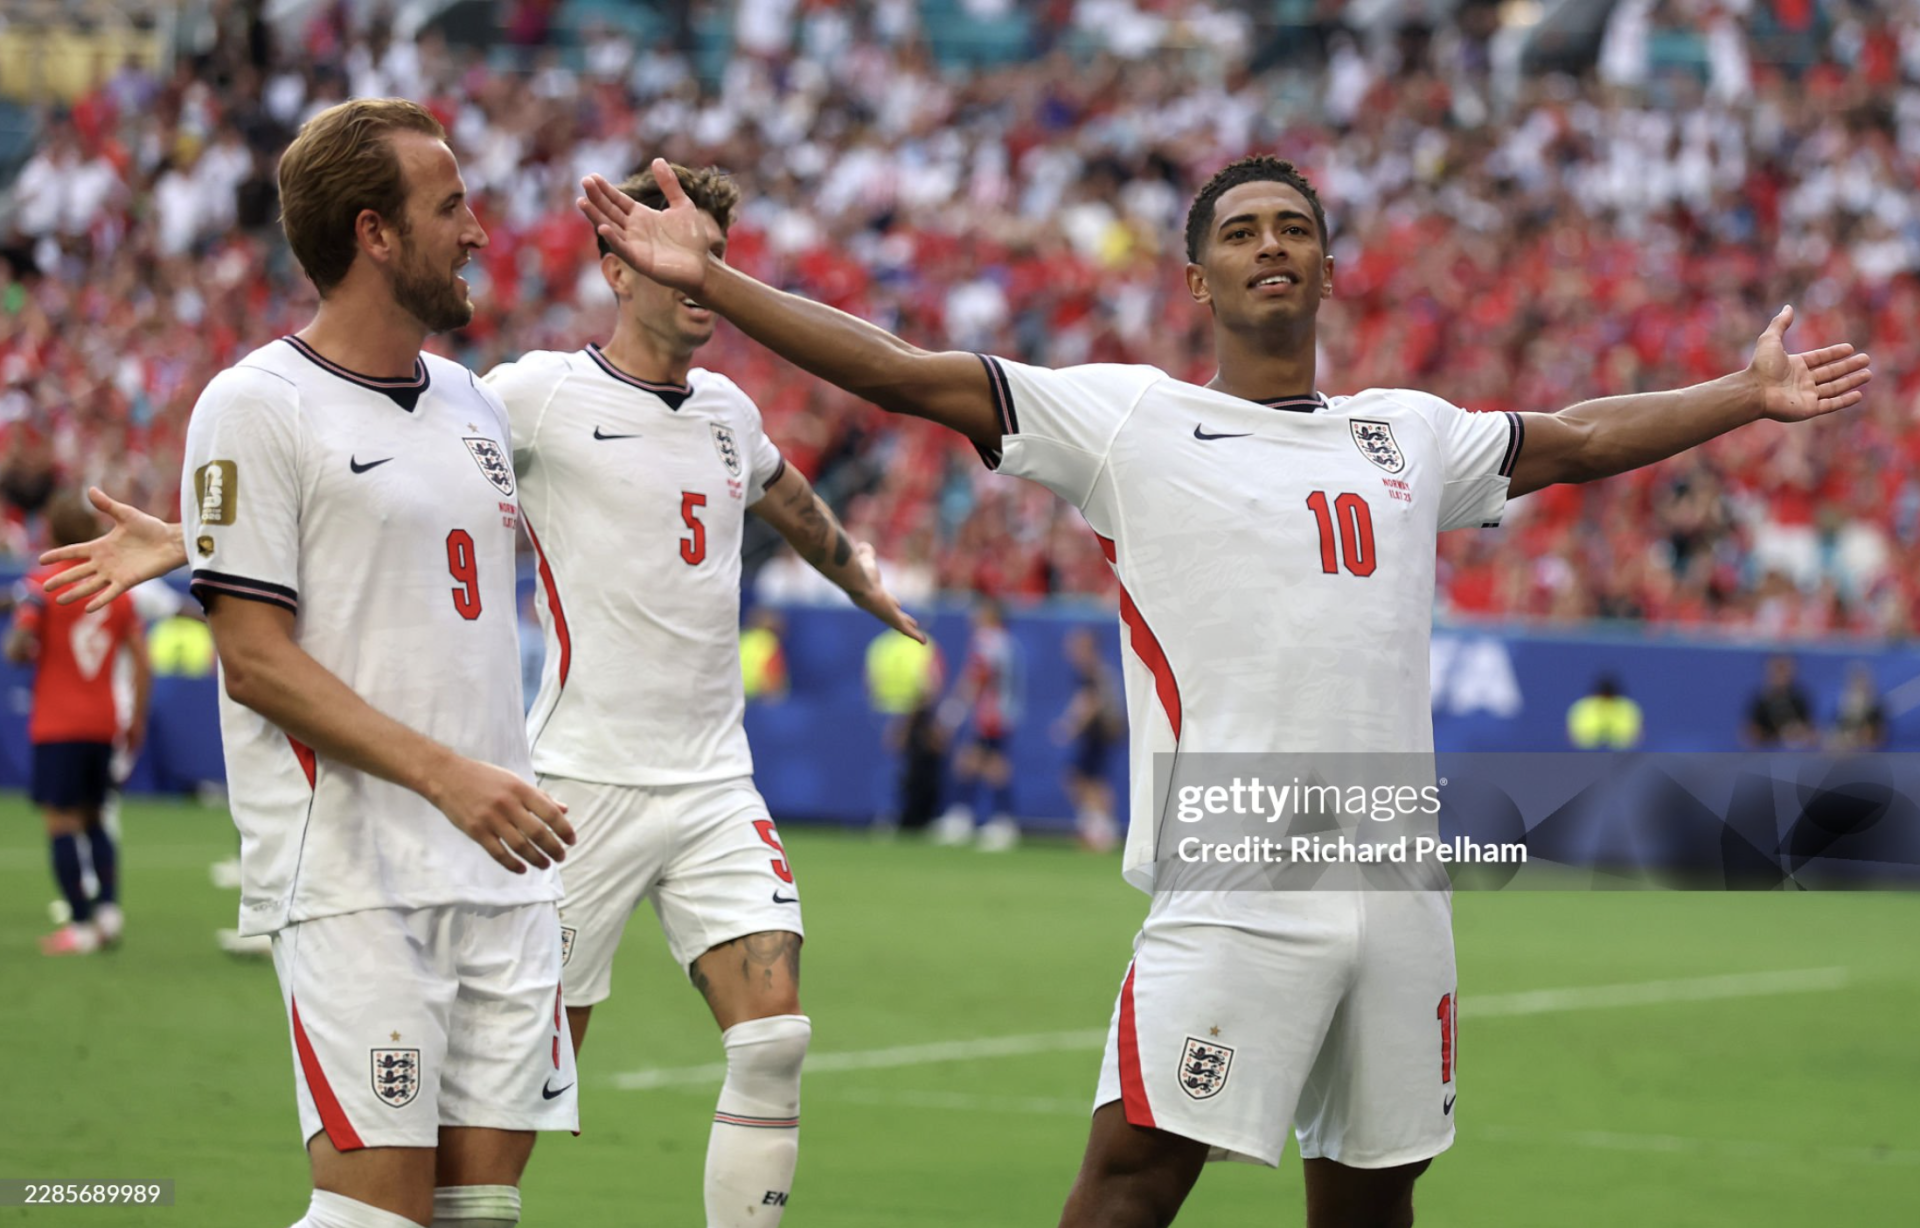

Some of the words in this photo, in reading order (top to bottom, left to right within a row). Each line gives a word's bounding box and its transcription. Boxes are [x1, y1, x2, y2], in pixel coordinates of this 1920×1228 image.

[1382, 478, 1410, 490] NORWAY
[680, 491, 706, 566] 5
[1306, 491, 1377, 577] 10
[446, 529, 482, 621] 9
[751, 819, 793, 884] 5
[1437, 991, 1458, 1084] 1
